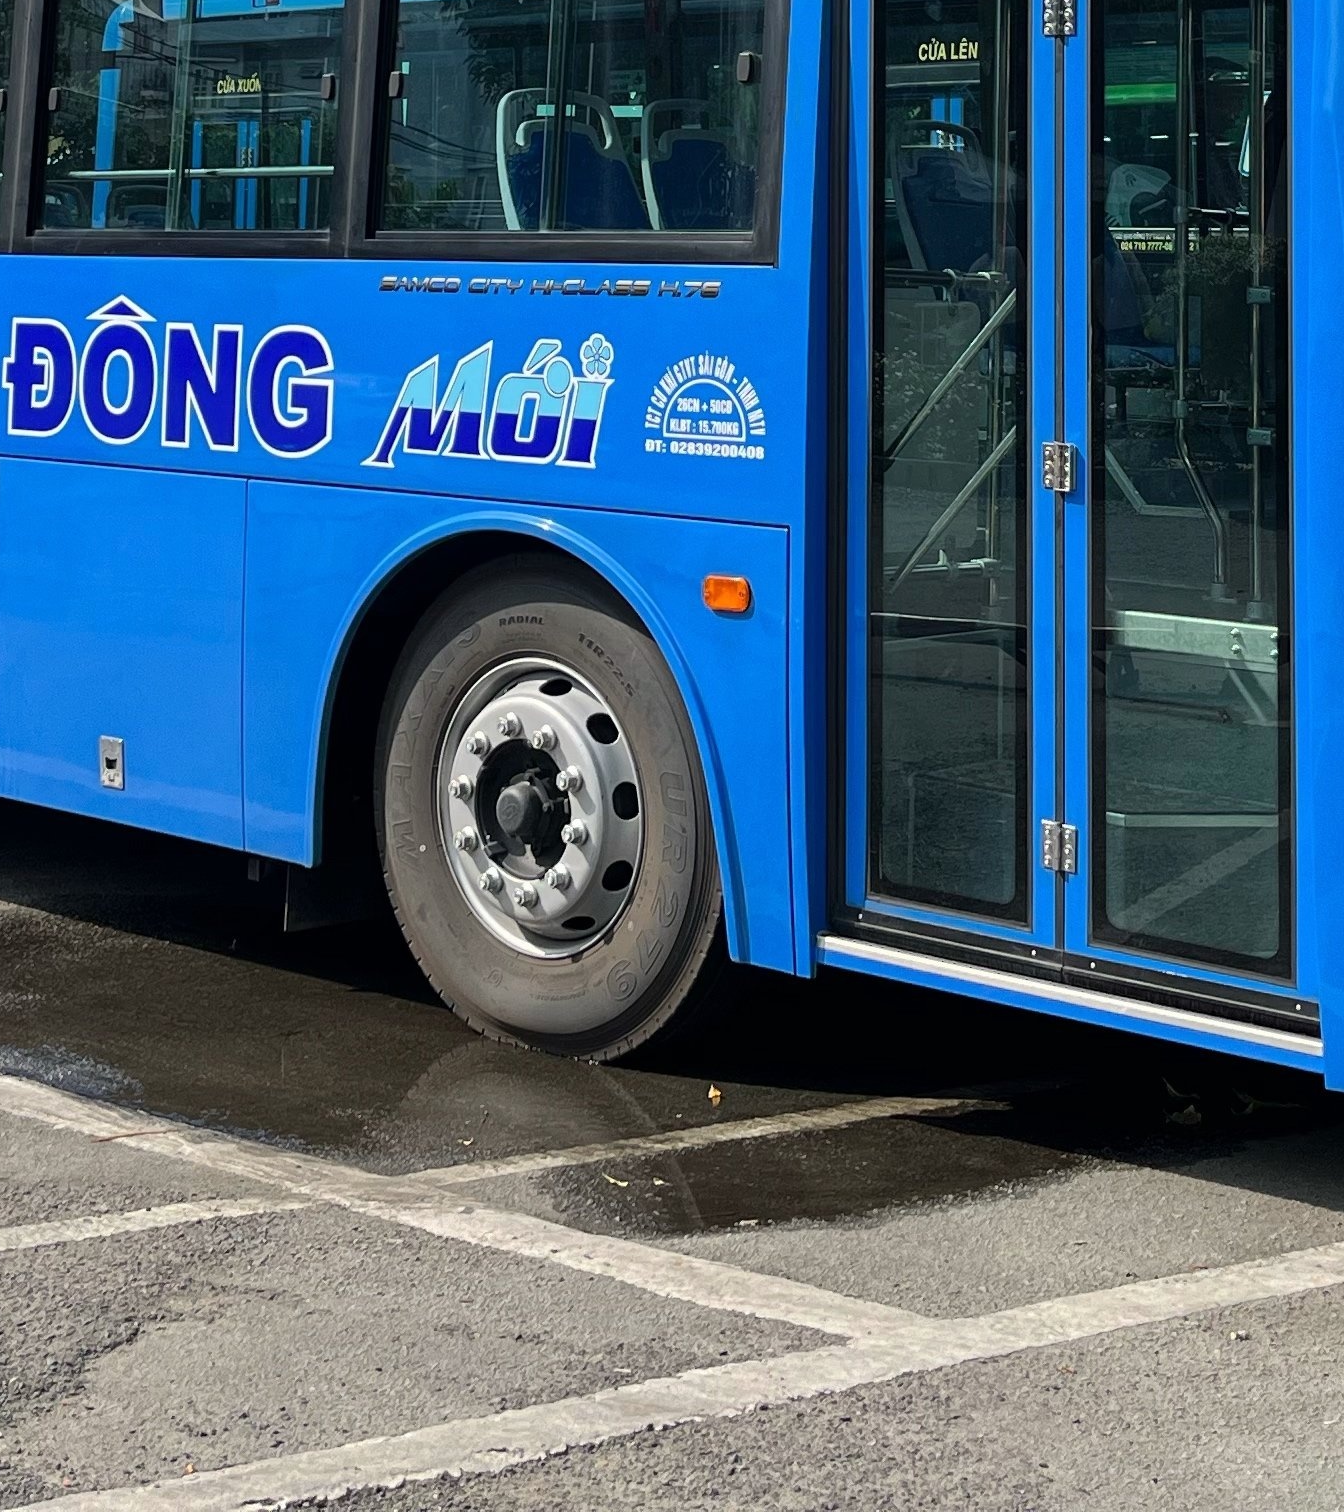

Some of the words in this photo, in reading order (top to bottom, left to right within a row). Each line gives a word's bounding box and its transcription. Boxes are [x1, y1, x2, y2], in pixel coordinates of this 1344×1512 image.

[918, 37, 947, 61] CỬA
[950, 37, 979, 60] LÊN
[216, 74, 236, 95] CỬA
[237, 72, 262, 93] XUỐN
[379, 276, 462, 294] SAMCO
[467, 278, 525, 295] CITY
[2, 294, 335, 459] ĐÔNG
[669, 440, 765, 460] 02839200408
[498, 615, 545, 628] RADIAL
